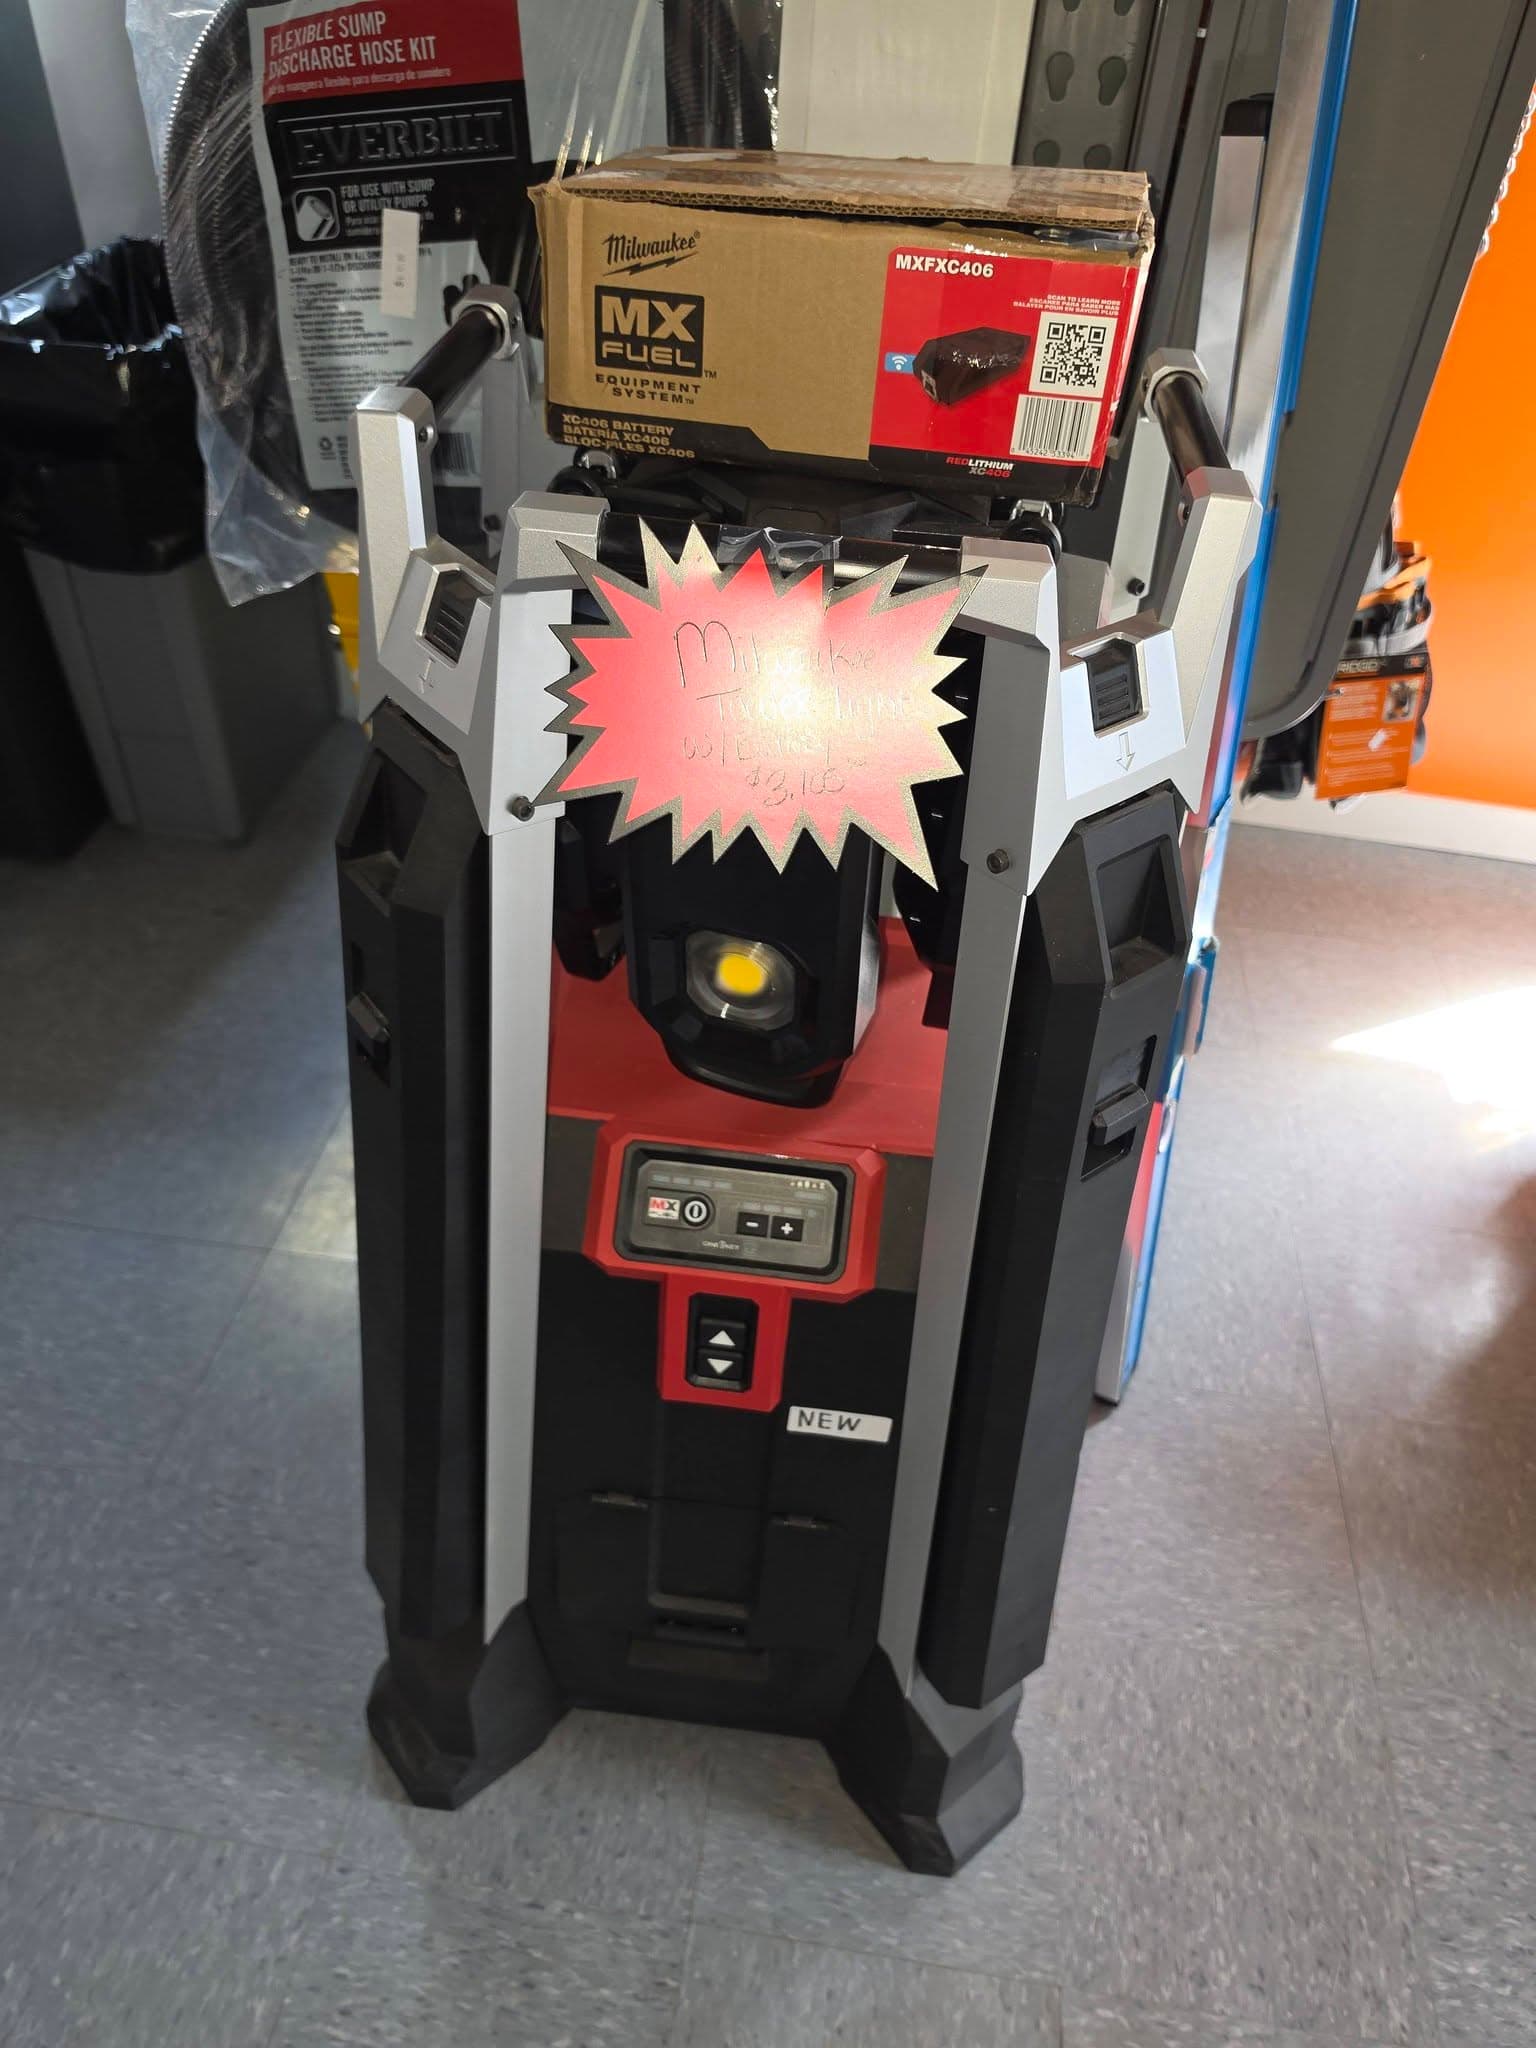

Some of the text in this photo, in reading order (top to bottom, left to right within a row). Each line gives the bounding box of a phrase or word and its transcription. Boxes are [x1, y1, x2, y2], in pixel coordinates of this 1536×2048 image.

[270, 11, 386, 56] FLEXIBLE SUMP
[269, 36, 436, 80] DISCHARGE HOSE KIT
[292, 111, 503, 165] EVERBILT
[341, 178, 435, 199] FOR USE WITH SUMP
[343, 194, 428, 214] OR UTILITY PUMPS
[895, 254, 994, 278] MXFXC406
[1078, 297, 1099, 305] LEARN
[602, 295, 696, 343] MX
[602, 341, 696, 368] FUEL
[595, 374, 701, 394] EQUIPMENT
[562, 413, 674, 436] XC406 BATTERY
[564, 435, 696, 458] BLOC-PILES XC406
[623, 432, 670, 447] XC406
[946, 456, 1014, 471] REDLITHIUM
[969, 467, 1010, 478] XC406
[797, 1409, 862, 1432] NEW
